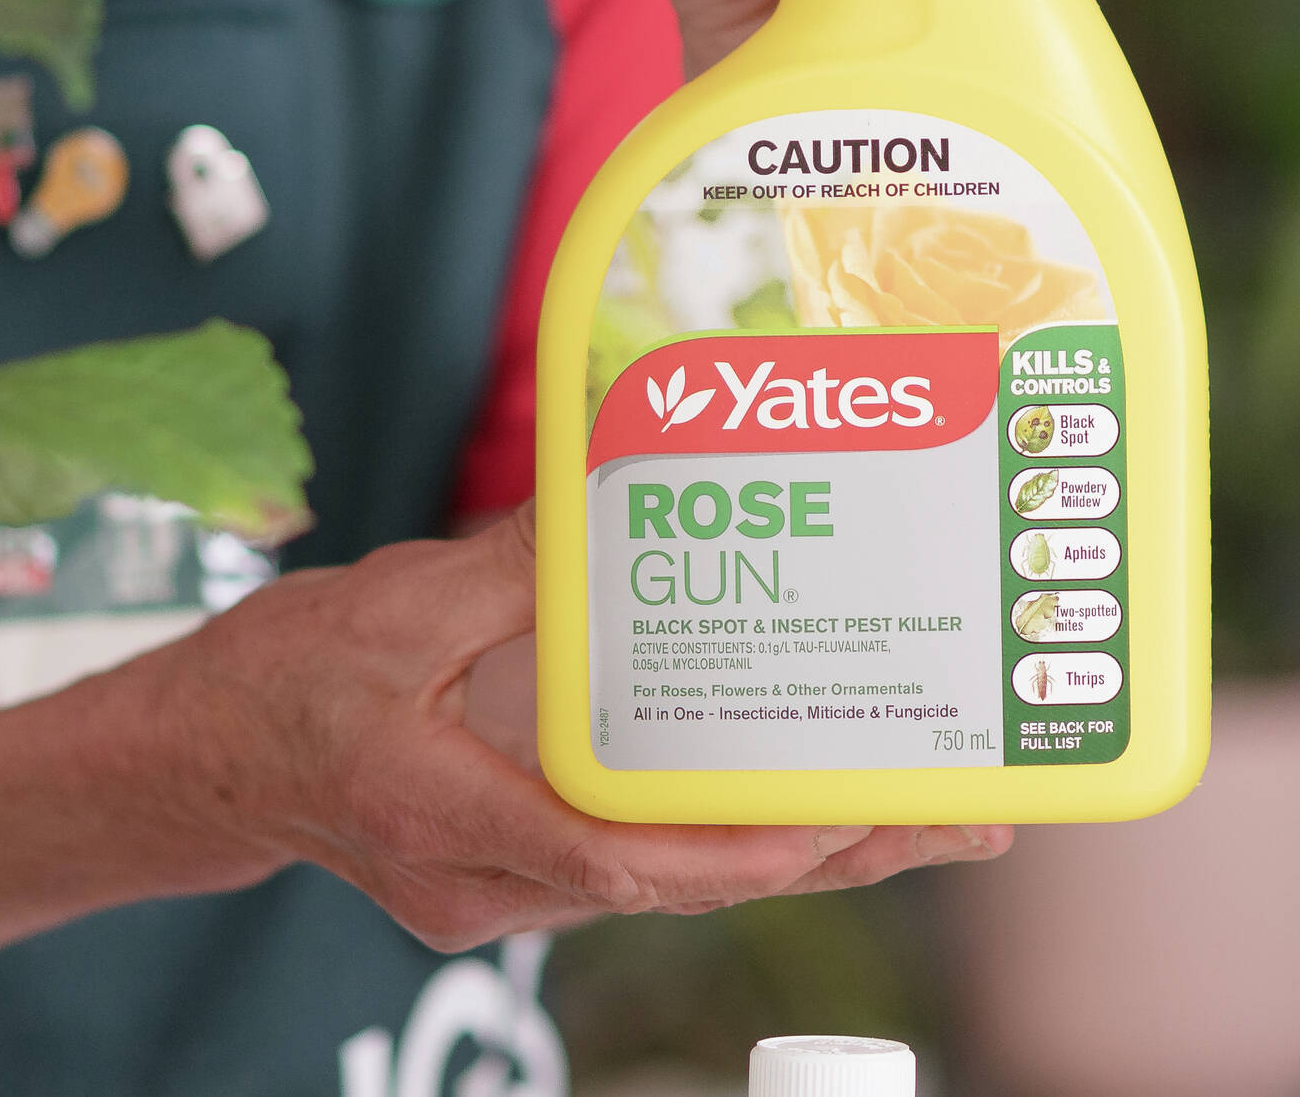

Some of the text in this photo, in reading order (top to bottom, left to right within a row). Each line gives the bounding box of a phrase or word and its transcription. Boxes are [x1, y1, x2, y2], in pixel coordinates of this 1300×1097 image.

[747, 137, 950, 176] CAUTION
[703, 181, 1000, 201] KEEP OUT OF REACH OF CHILDREN
[1012, 349, 1111, 376] KILLS &
[1010, 377, 1112, 395] CONTROLS
[1060, 414, 1095, 429] Black
[1060, 430, 1089, 447] Spot
[1061, 480, 1107, 496] Powdery
[628, 480, 834, 540] ROSE
[1061, 495, 1101, 509] Mildew
[1064, 546, 1106, 563] Aphids
[1054, 603, 1117, 619] Two-spotted
[632, 616, 962, 635] BLACK SPOT & INSECT PEST KILLER
[1055, 619, 1084, 631] mites
[632, 640, 891, 656] ACTIVE CONSTITUENTS: 0.1g/L TAU-FLUVALINATE,
[632, 657, 753, 672] 0.05g/L MYCLOBUTANIL
[1066, 671, 1105, 688] Thrips
[633, 682, 924, 699] For Roses, Flowers & Other Ornamentals
[634, 707, 652, 721] All
[656, 706, 669, 721] in
[673, 706, 704, 721] One
[719, 706, 803, 722] Insecticide,
[807, 705, 865, 719] Miticide
[870, 705, 880, 719] &
[885, 704, 958, 721] Fungicide
[1020, 720, 1114, 735] SEE BACK FOR
[932, 729, 996, 751] 750 mL
[1020, 736, 1082, 750] FULL LIST
